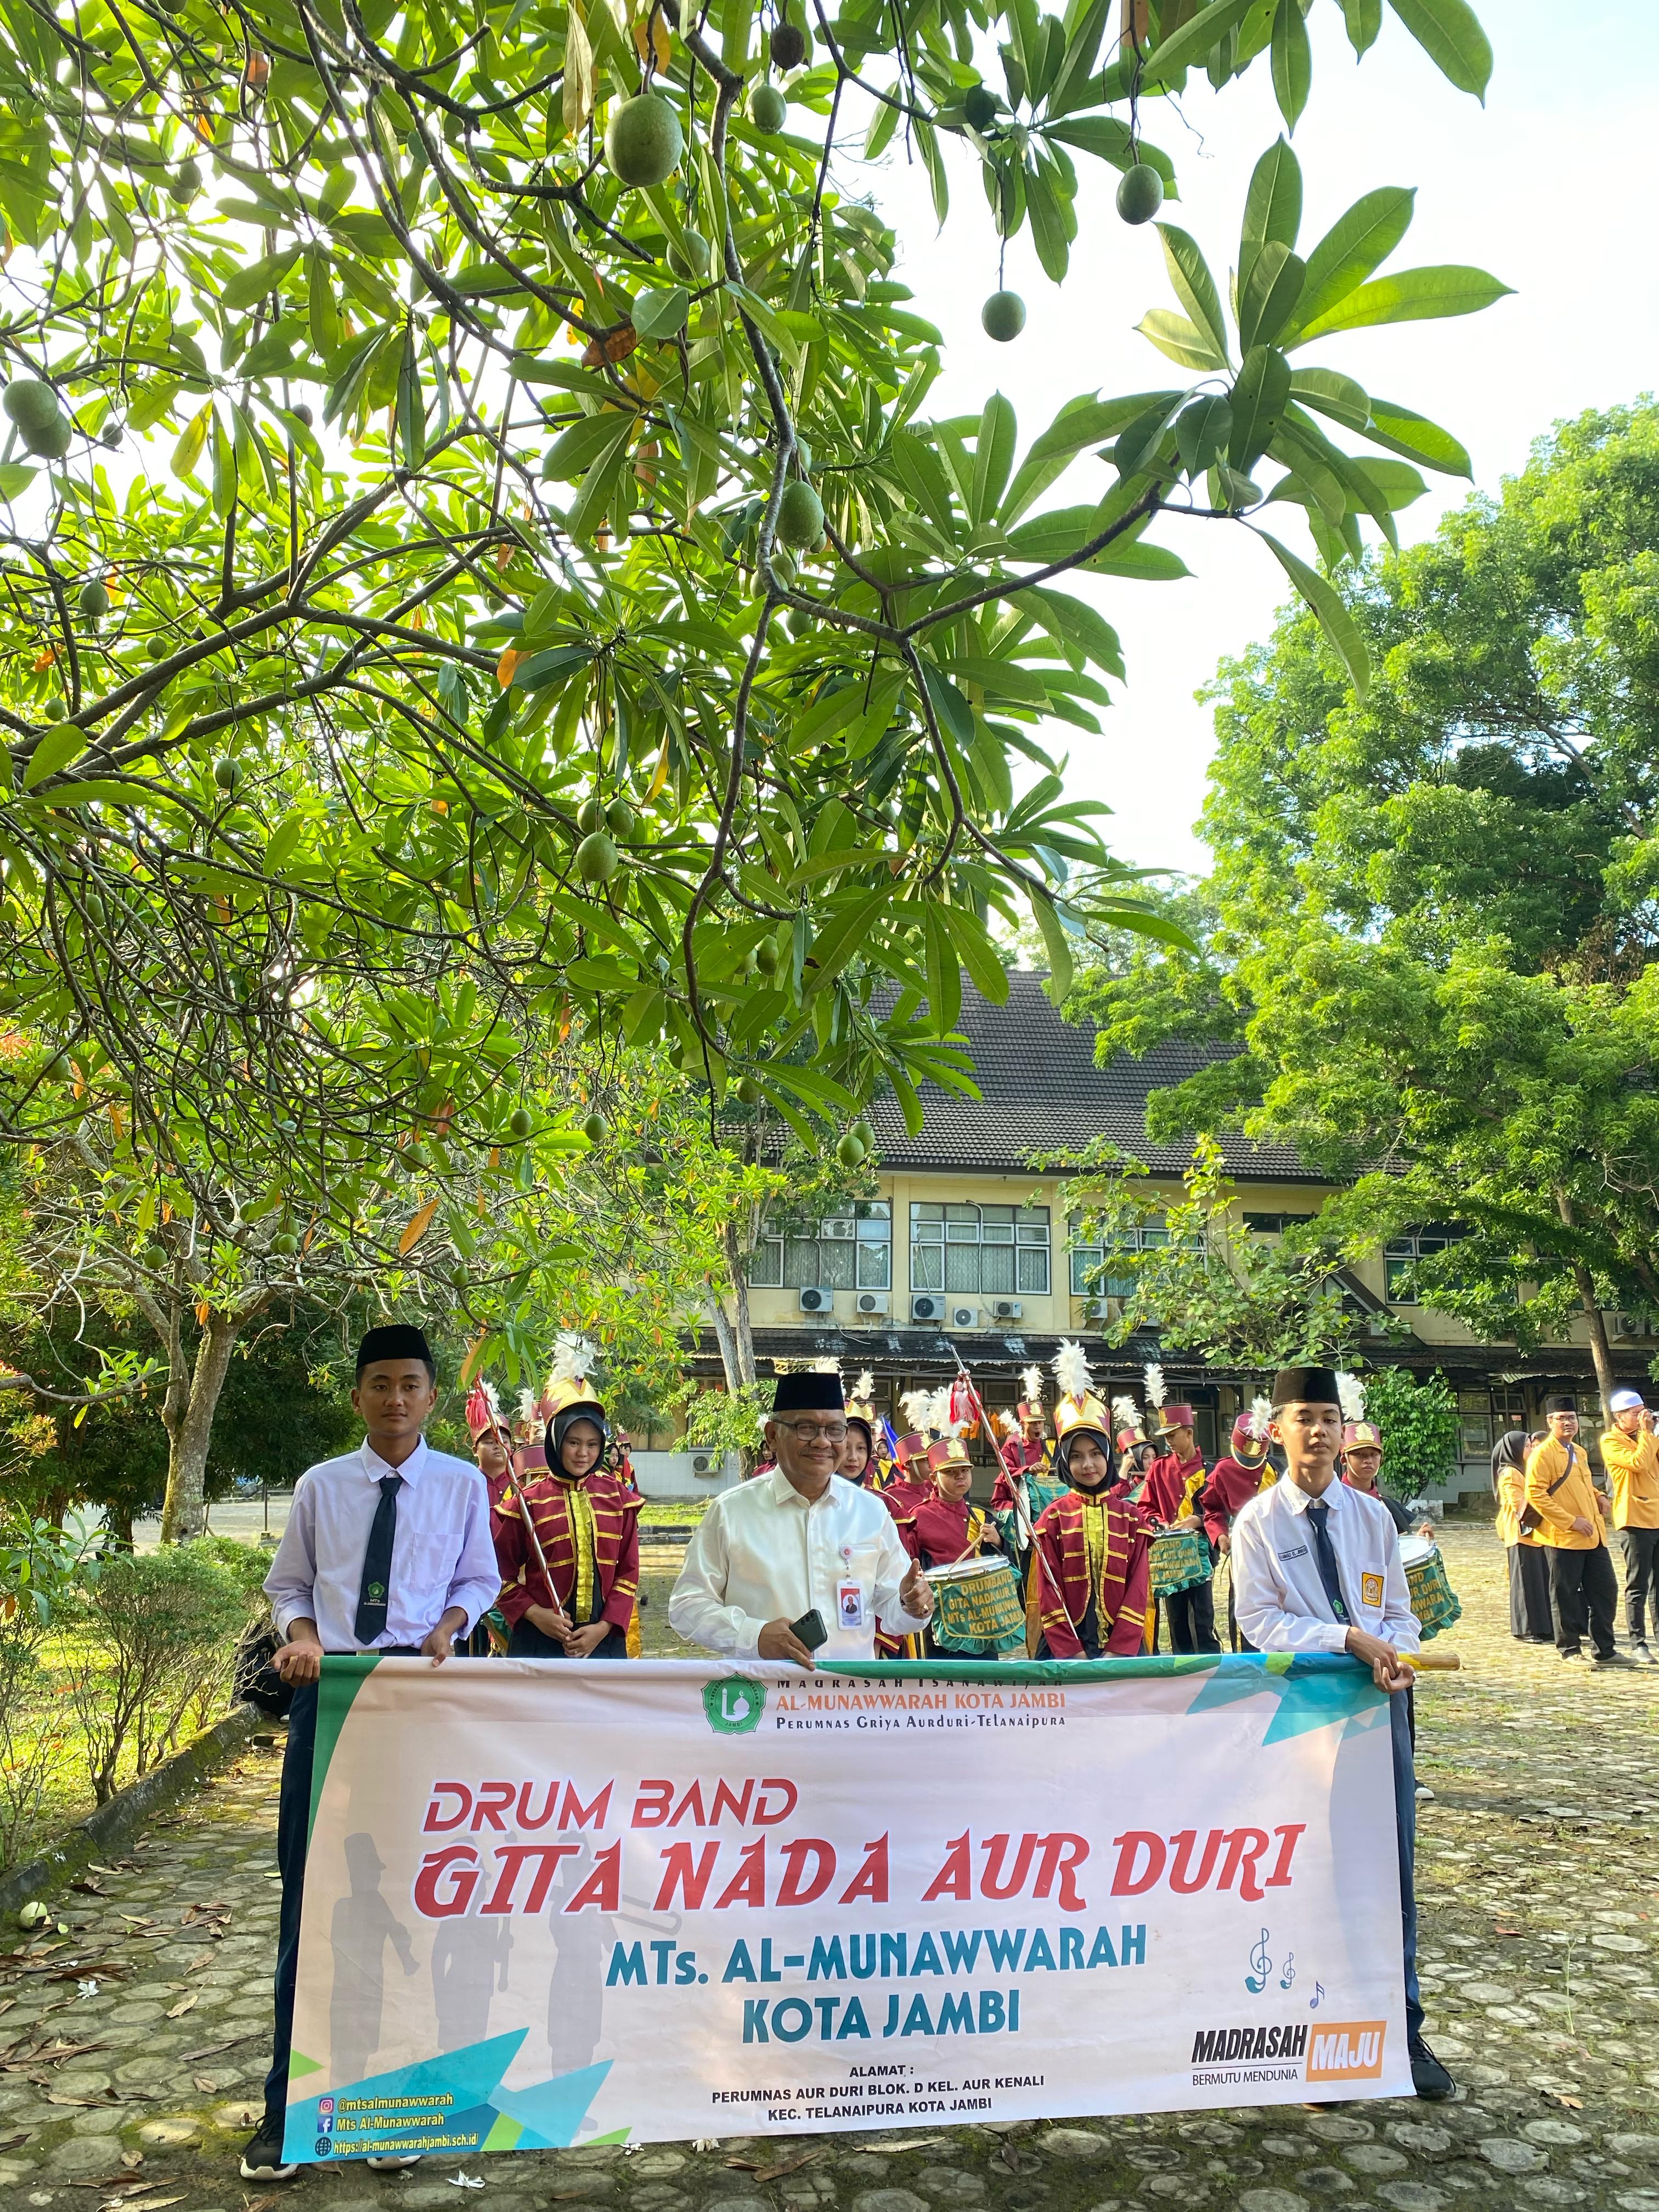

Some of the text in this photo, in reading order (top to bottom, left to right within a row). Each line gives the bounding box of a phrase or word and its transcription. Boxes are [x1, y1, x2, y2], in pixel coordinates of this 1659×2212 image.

[961, 1571, 1013, 1596] DRUMBAND
[949, 1598, 970, 1610] GITA
[972, 1592, 996, 1605] NADA
[969, 1618, 998, 1634] KOTA
[776, 1693, 1065, 1711] AL-MUNAWWARAH KOTA JAMBI
[423, 1778, 798, 1831] DRUM BAND
[414, 1824, 1306, 1916] GITA NADA AUR DURI
[605, 1924, 1148, 1987] MTs. AL-MUNAWWARAH
[743, 1989, 1019, 2044] KOTA JAMBI
[1191, 2024, 1381, 2070] MADRASAH MAJU
[849, 2065, 905, 2078] ALAMAT
[1193, 2069, 1298, 2086] BERMUTU MENDUNIA
[712, 2075, 1045, 2103] PERUMNAS AUR DURI BLOK. D KEL. AUR KENALI
[338, 2092, 454, 2113] @mtsalmunawwarah
[768, 2097, 992, 2121] KEC. TELANAIPURA KOTA JAMBI
[336, 2112, 444, 2131] Mts Al-Munawwarah
